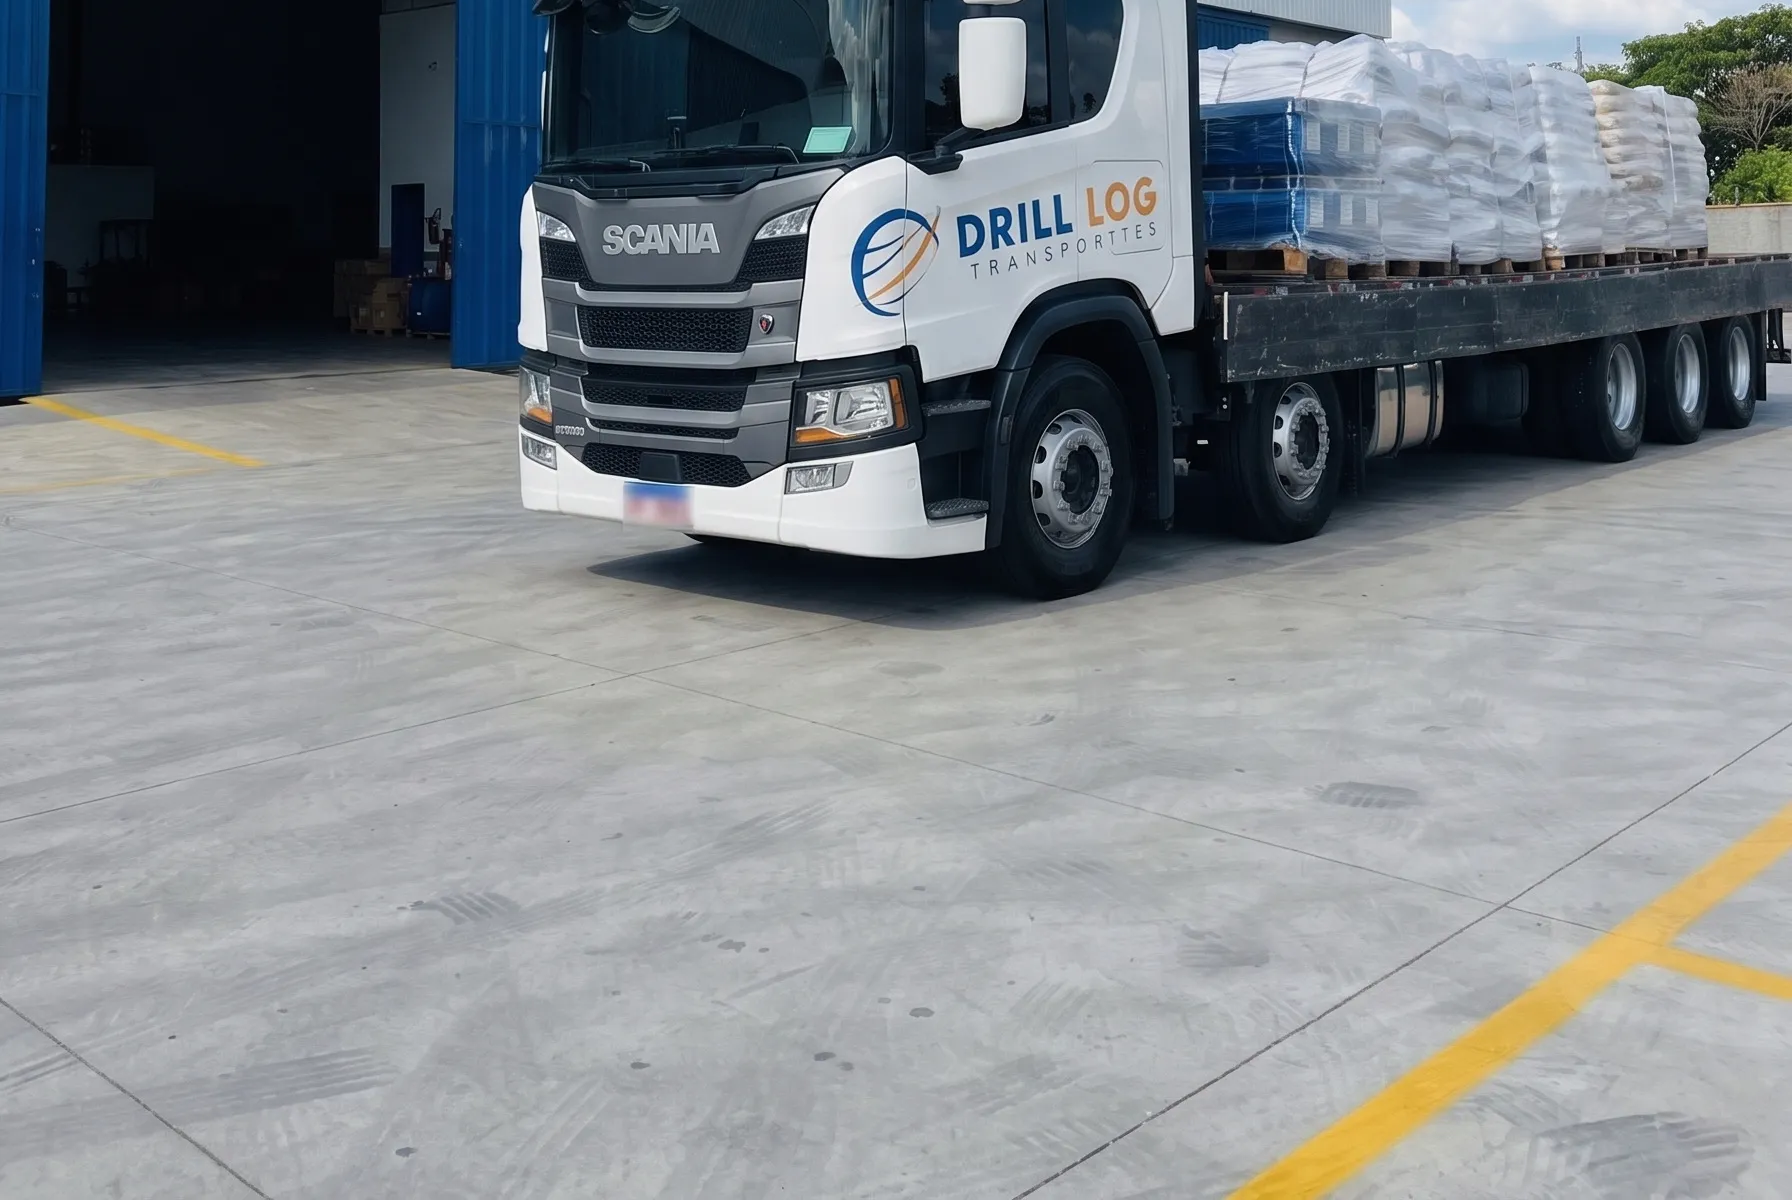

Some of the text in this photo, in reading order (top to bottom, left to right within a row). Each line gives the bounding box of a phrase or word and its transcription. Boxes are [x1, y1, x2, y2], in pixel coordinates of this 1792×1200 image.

[602, 222, 720, 255] SCANIA
[957, 176, 1157, 258] DRILL LOG
[970, 222, 1156, 279] TRANSPORTTES
